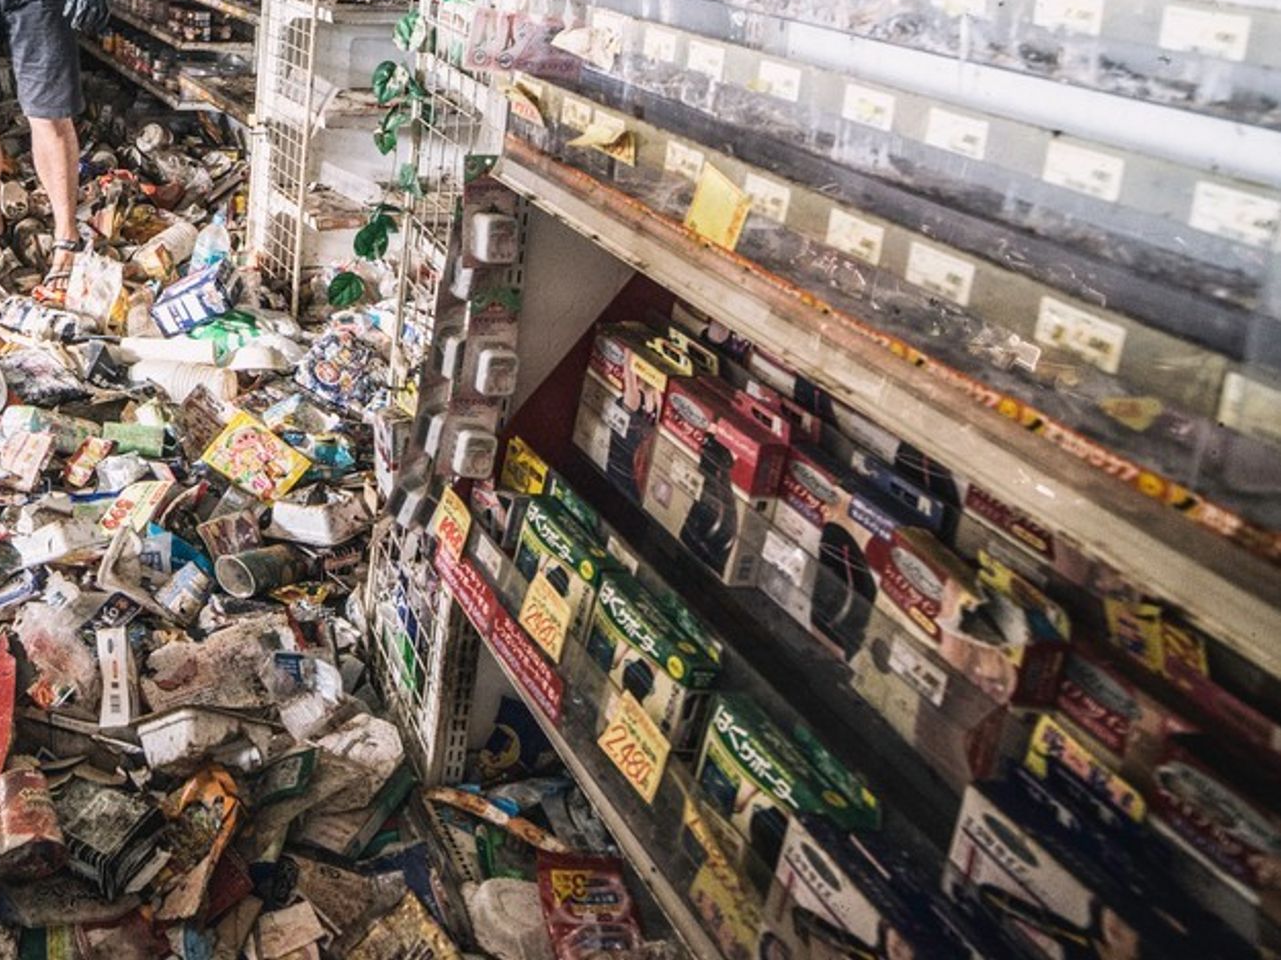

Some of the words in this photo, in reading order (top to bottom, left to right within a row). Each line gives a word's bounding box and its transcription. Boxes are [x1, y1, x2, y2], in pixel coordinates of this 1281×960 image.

[600, 580, 662, 658] はくサポーター
[715, 703, 801, 809] はくサポーター
